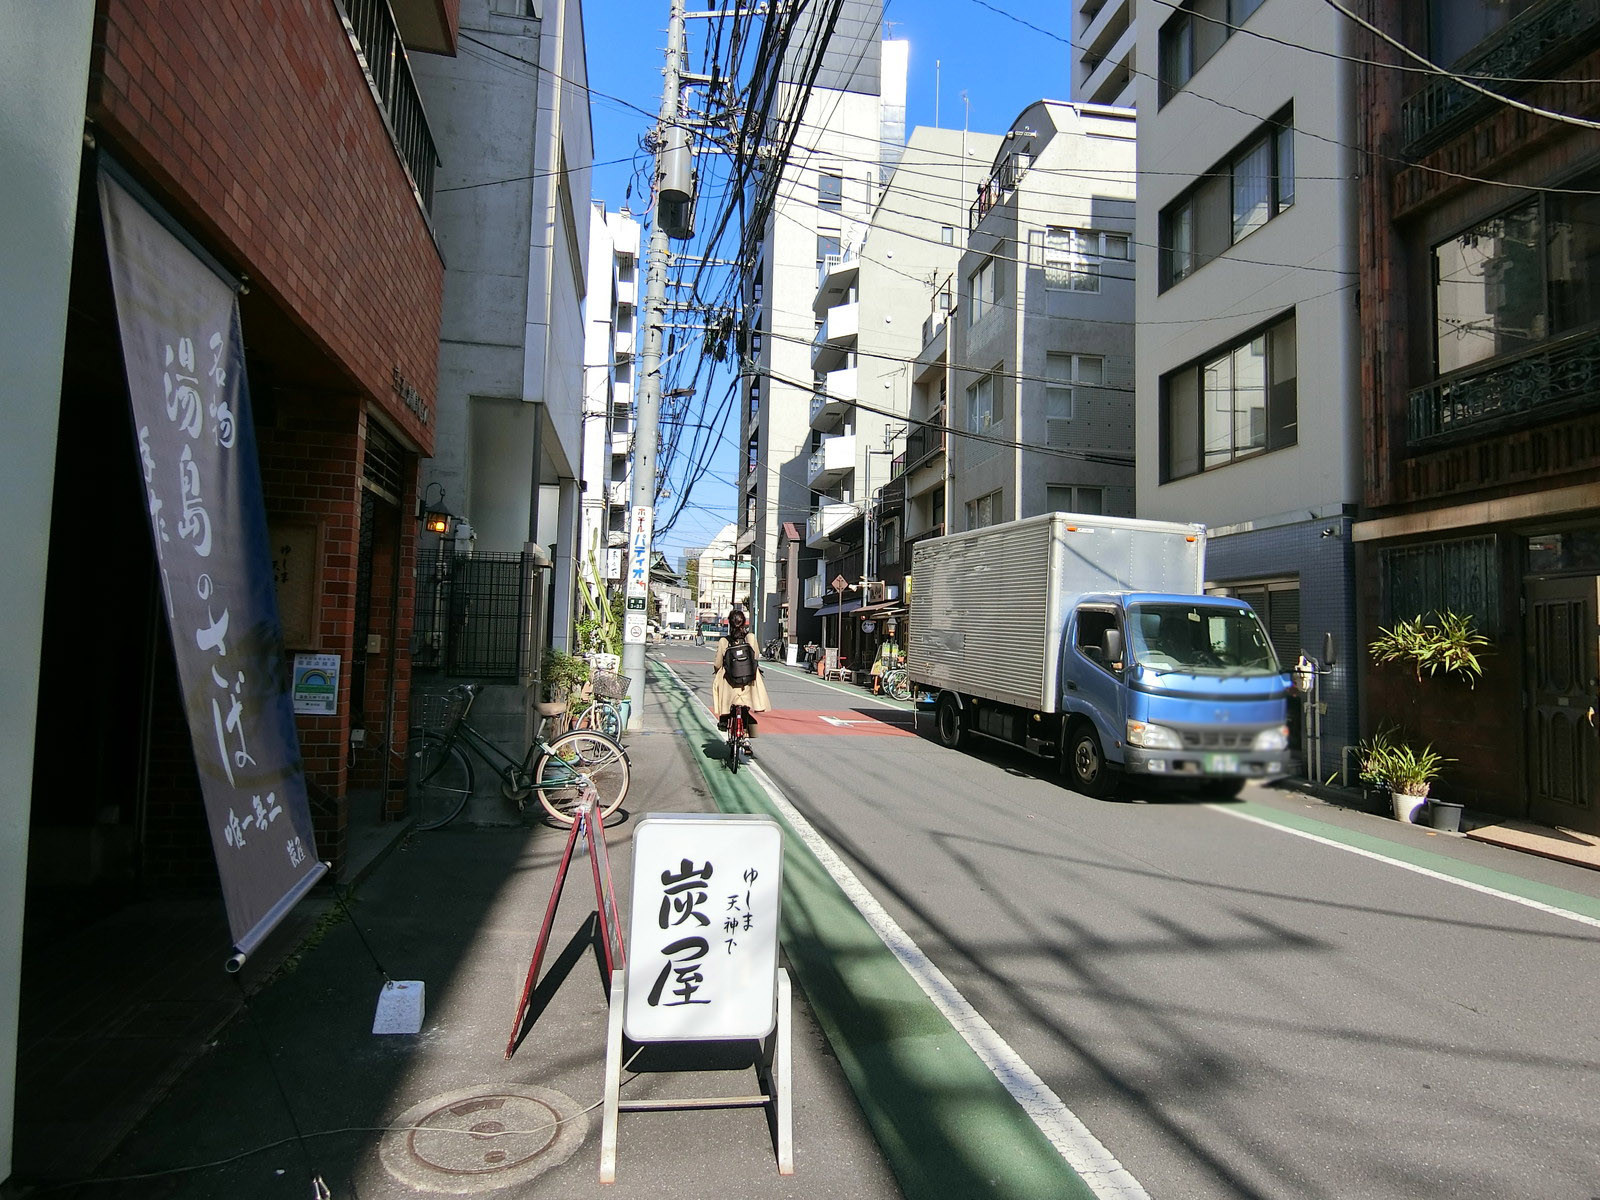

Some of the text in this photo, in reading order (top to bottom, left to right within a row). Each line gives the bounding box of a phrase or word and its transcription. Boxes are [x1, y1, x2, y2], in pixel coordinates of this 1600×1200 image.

[163, 337, 257, 789] 湯島のさば
[647, 857, 714, 1007] 炭屋
[742, 866, 759, 931] ゆしま
